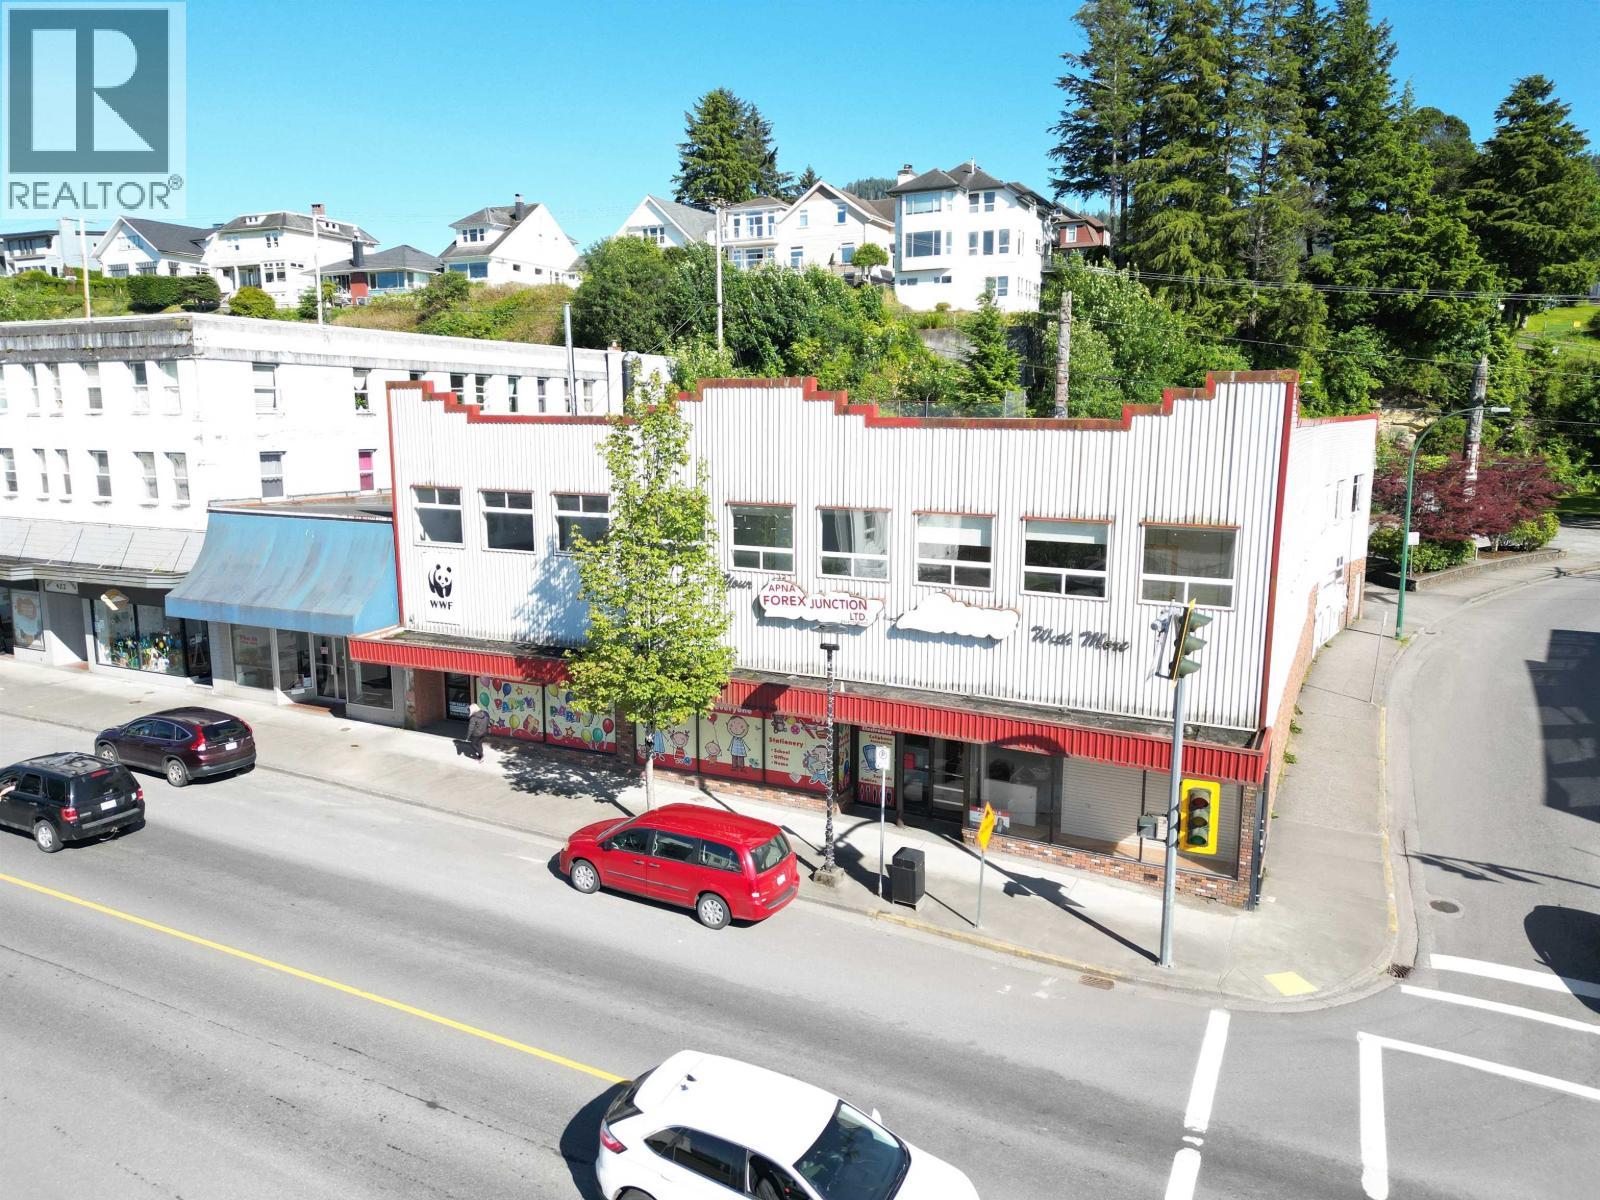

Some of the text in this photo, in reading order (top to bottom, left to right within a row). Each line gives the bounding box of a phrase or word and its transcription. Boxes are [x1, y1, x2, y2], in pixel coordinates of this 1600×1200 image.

[768, 584, 796, 592] APNA
[430, 600, 454, 610] WWF
[763, 595, 868, 611] FOREX JUNCTION
[1031, 626, 1130, 652] With More
[768, 737, 804, 748] Stationery
